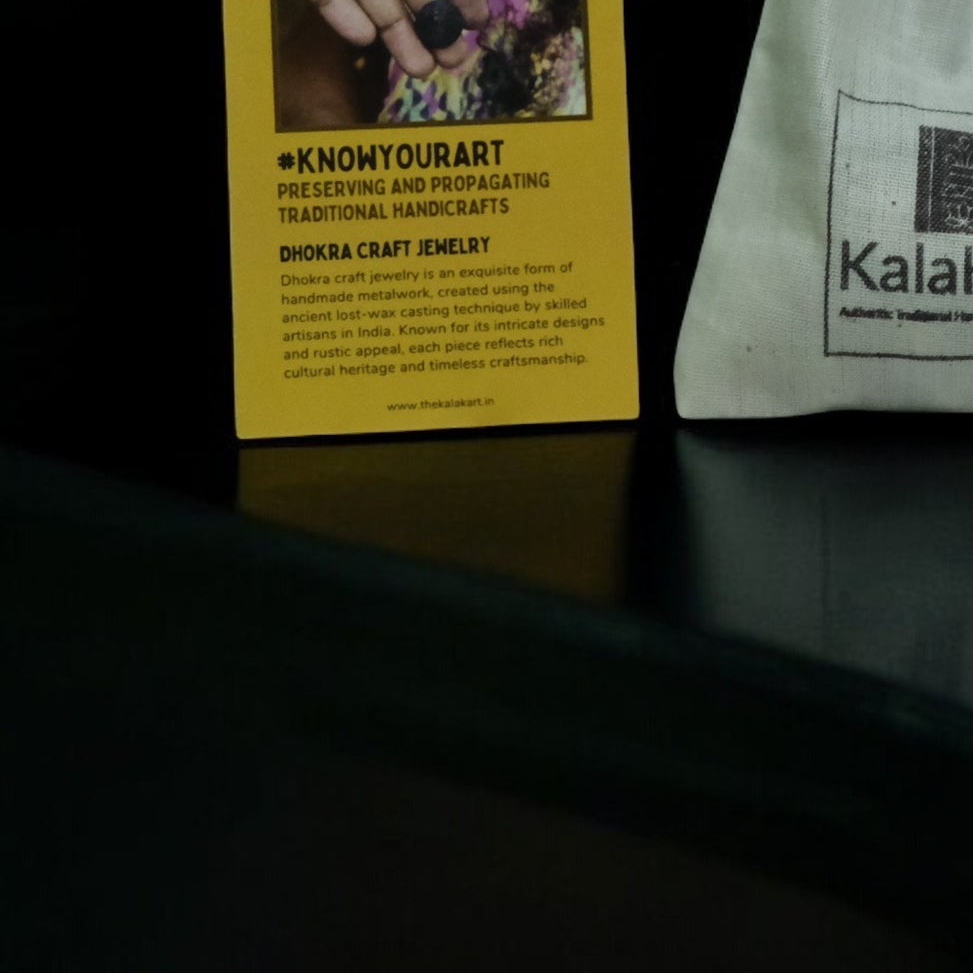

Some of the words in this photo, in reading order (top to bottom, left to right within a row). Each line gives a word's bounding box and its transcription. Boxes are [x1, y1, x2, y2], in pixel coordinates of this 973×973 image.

[276, 139, 504, 175] #KNOWYOURART
[276, 178, 386, 200] PRESERVING
[390, 176, 427, 195] AND
[430, 171, 550, 193] PROPAGATING
[277, 202, 388, 224] TRADITIONAL
[392, 196, 510, 219] HANDICRAFTS
[279, 242, 353, 263] DHOKRA
[356, 239, 412, 259] CRAFT
[416, 235, 490, 257] JEWELRY
[280, 273, 331, 287] Dhokra
[334, 270, 367, 284] craft
[368, 268, 420, 285] jewelry
[423, 267, 434, 280] is
[438, 269, 455, 279] an
[458, 264, 520, 279] exquisite
[523, 262, 556, 275] form
[559, 260, 573, 274] of
[280, 290, 354, 305] handmade
[357, 286, 434, 302] metalwork,
[436, 283, 489, 298] created
[491, 284, 530, 297] using
[532, 280, 555, 293] the
[281, 310, 333, 324] ancient
[335, 308, 396, 321] lost-wax
[399, 304, 450, 319] casting
[452, 301, 520, 316] technique
[523, 299, 541, 314] by
[544, 296, 587, 311] skilled
[282, 329, 337, 343] artisans
[340, 328, 354, 339] in
[357, 325, 395, 338] India.
[398, 323, 447, 336] Known
[449, 321, 470, 334] for
[473, 320, 490, 332] its
[493, 318, 549, 331] intricate
[552, 316, 605, 330] designs
[283, 347, 309, 361] and
[312, 345, 351, 359] rustic
[355, 342, 405, 359] appeal,
[408, 340, 441, 354] each
[444, 340, 481, 354] piece
[484, 336, 535, 350] reflects
[538, 334, 564, 347] rich
[283, 364, 336, 379] cultural
[338, 362, 396, 377] heritage
[399, 359, 425, 373] and
[428, 357, 486, 372] timeless
[488, 352, 588, 369] craftsmanship.
[386, 397, 495, 411] www.thekalakart.in
